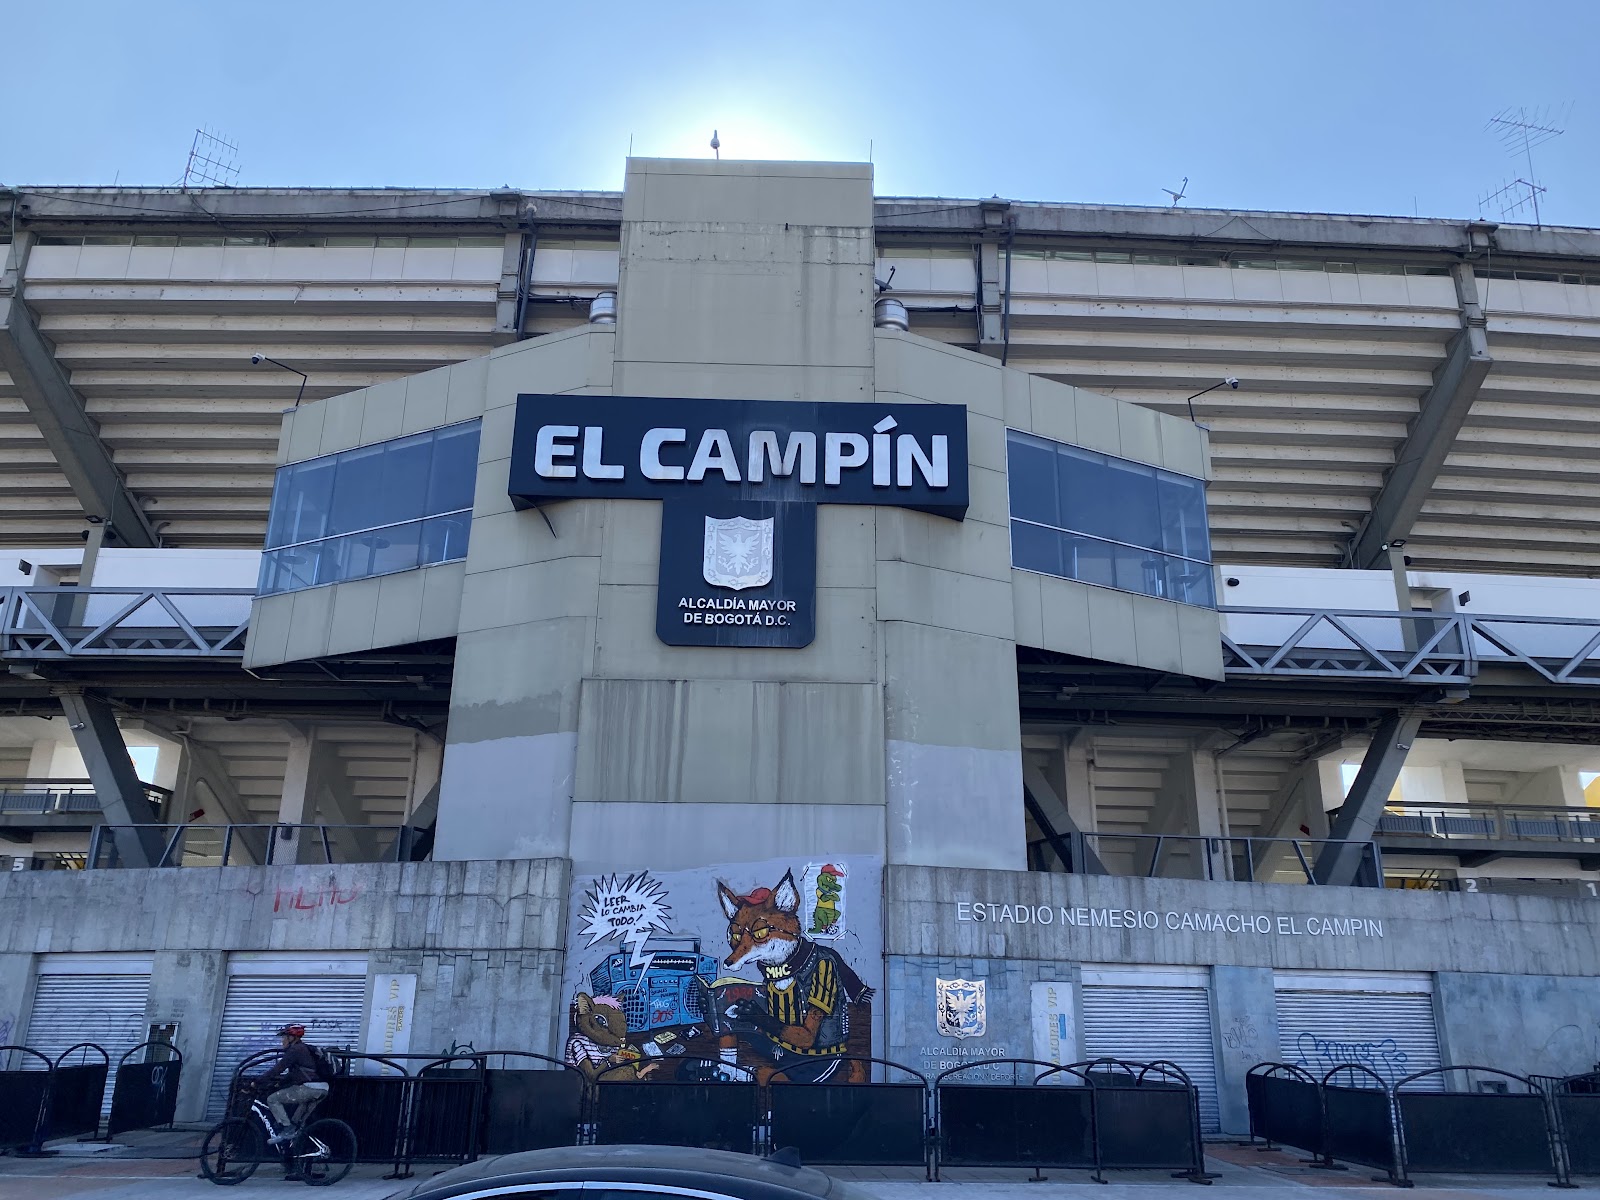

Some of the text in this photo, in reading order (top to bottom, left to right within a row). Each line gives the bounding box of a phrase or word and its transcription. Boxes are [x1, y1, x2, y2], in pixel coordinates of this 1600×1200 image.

[534, 414, 950, 488] EL CAMPÍN
[678, 596, 797, 612] ALCALDÍA MAYOR
[683, 612, 791, 626] DE BOGOTÁ D.C.
[12, 858, 25, 871] 5
[1465, 879, 1478, 893] 2
[1586, 882, 1597, 897] 1
[604, 895, 630, 907] LEER
[601, 904, 647, 917] LO CAMBIA
[608, 914, 643, 927] TODO!
[957, 902, 1384, 938] ESTADIO NEMESIO CAMACHO EL CAMPIN
[766, 963, 792, 978] MHC
[389, 979, 400, 1000] VIP
[1048, 987, 1057, 1008] VIP
[920, 1046, 1006, 1057] ALCALDÍA MAYOR
[923, 1060, 937, 1070] DE
